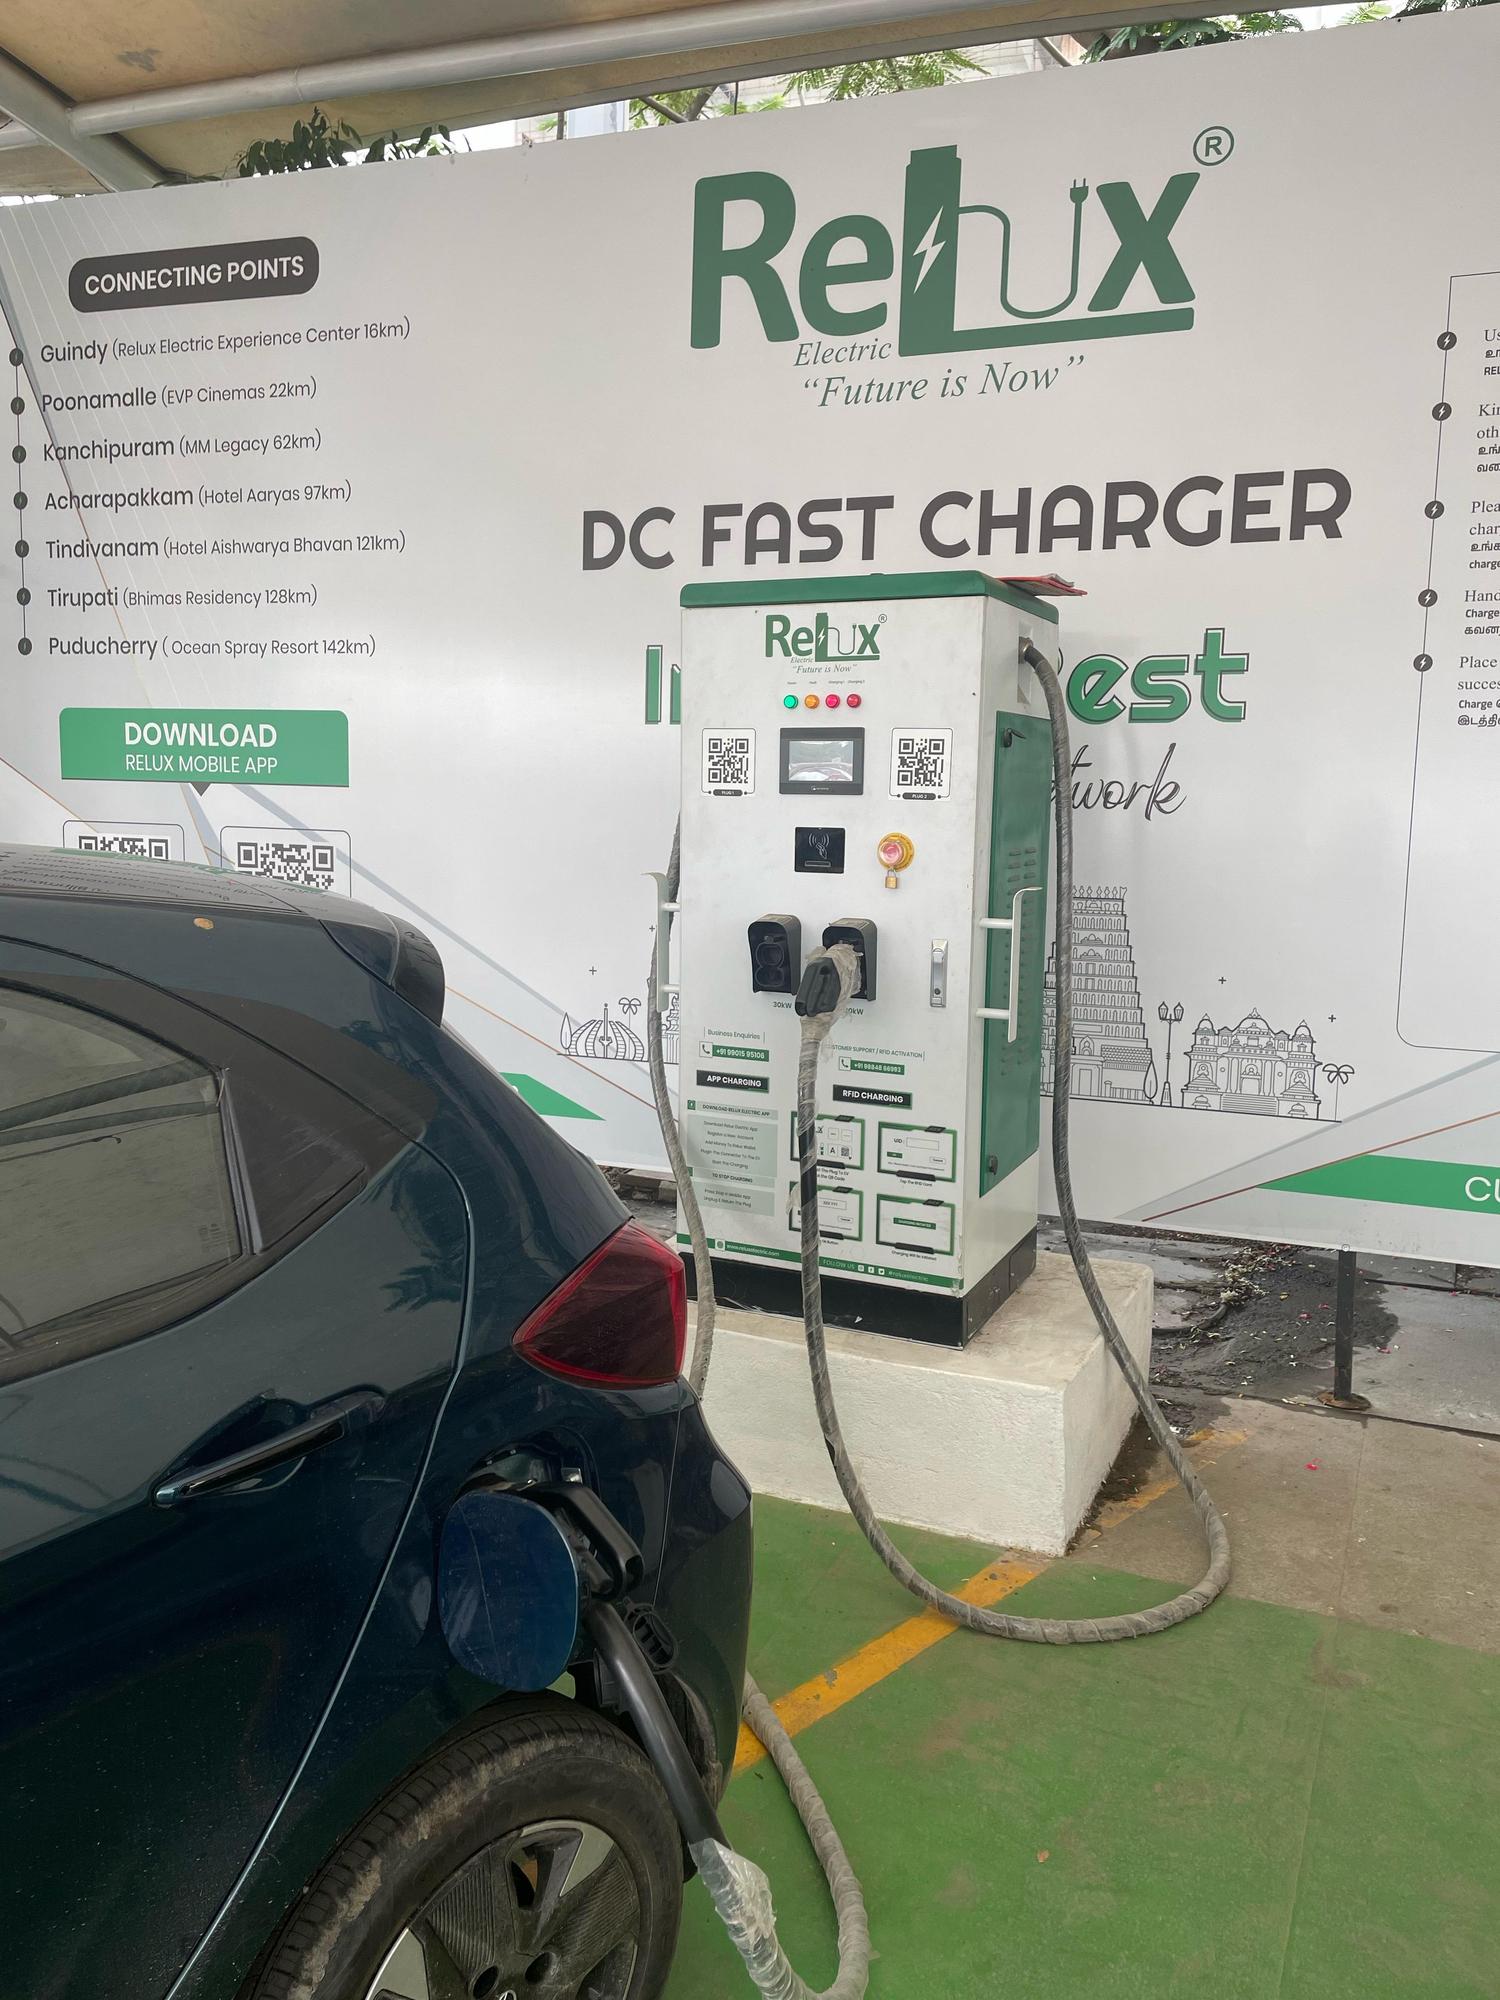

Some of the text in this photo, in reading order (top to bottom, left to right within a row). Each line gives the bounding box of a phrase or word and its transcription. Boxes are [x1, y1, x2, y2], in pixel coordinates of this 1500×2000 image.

[84, 255, 304, 295] CONNECTING POINTS
[40, 315, 411, 364] Guindy (Relux Electric Experience Center 16km)
[794, 337, 892, 367] Electric
[42, 376, 317, 412] Poonamalle (EVP Cinemas 22km)
[940, 367, 967, 397] is
[43, 428, 322, 464] Kanchipuram (MM Legacy 62km)
[45, 479, 352, 514] Acharapakkam (Hotel Aaryas 97km)
[582, 467, 1353, 571] DC FAST CHARGER
[46, 530, 406, 559] Tindivanam (Hotel Aishwarya Bhavan 121km)
[47, 584, 318, 612] Tirupati (Bhimas Residency 128km)
[1465, 608, 1499, 620] Charge
[49, 637, 158, 661] Puducherry
[171, 639, 221, 655] Ocean
[224, 639, 268, 659] Spray
[271, 639, 319, 656] Resort
[323, 634, 377, 658] 142km)
[790, 656, 814, 664] Electric
[1459, 655, 1498, 668] Place
[824, 664, 831, 673] is
[1056, 628, 1250, 725] est
[1458, 699, 1493, 710] Charge
[124, 721, 277, 749] DOWNLOAD
[125, 754, 278, 775] RELUX MOBILE APP
[846, 1007, 864, 1015] 0kW
[707, 1028, 761, 1040] Business Enquiries
[706, 1074, 762, 1088] APP CHARGING
[842, 1089, 904, 1104] RFID CHARGING
